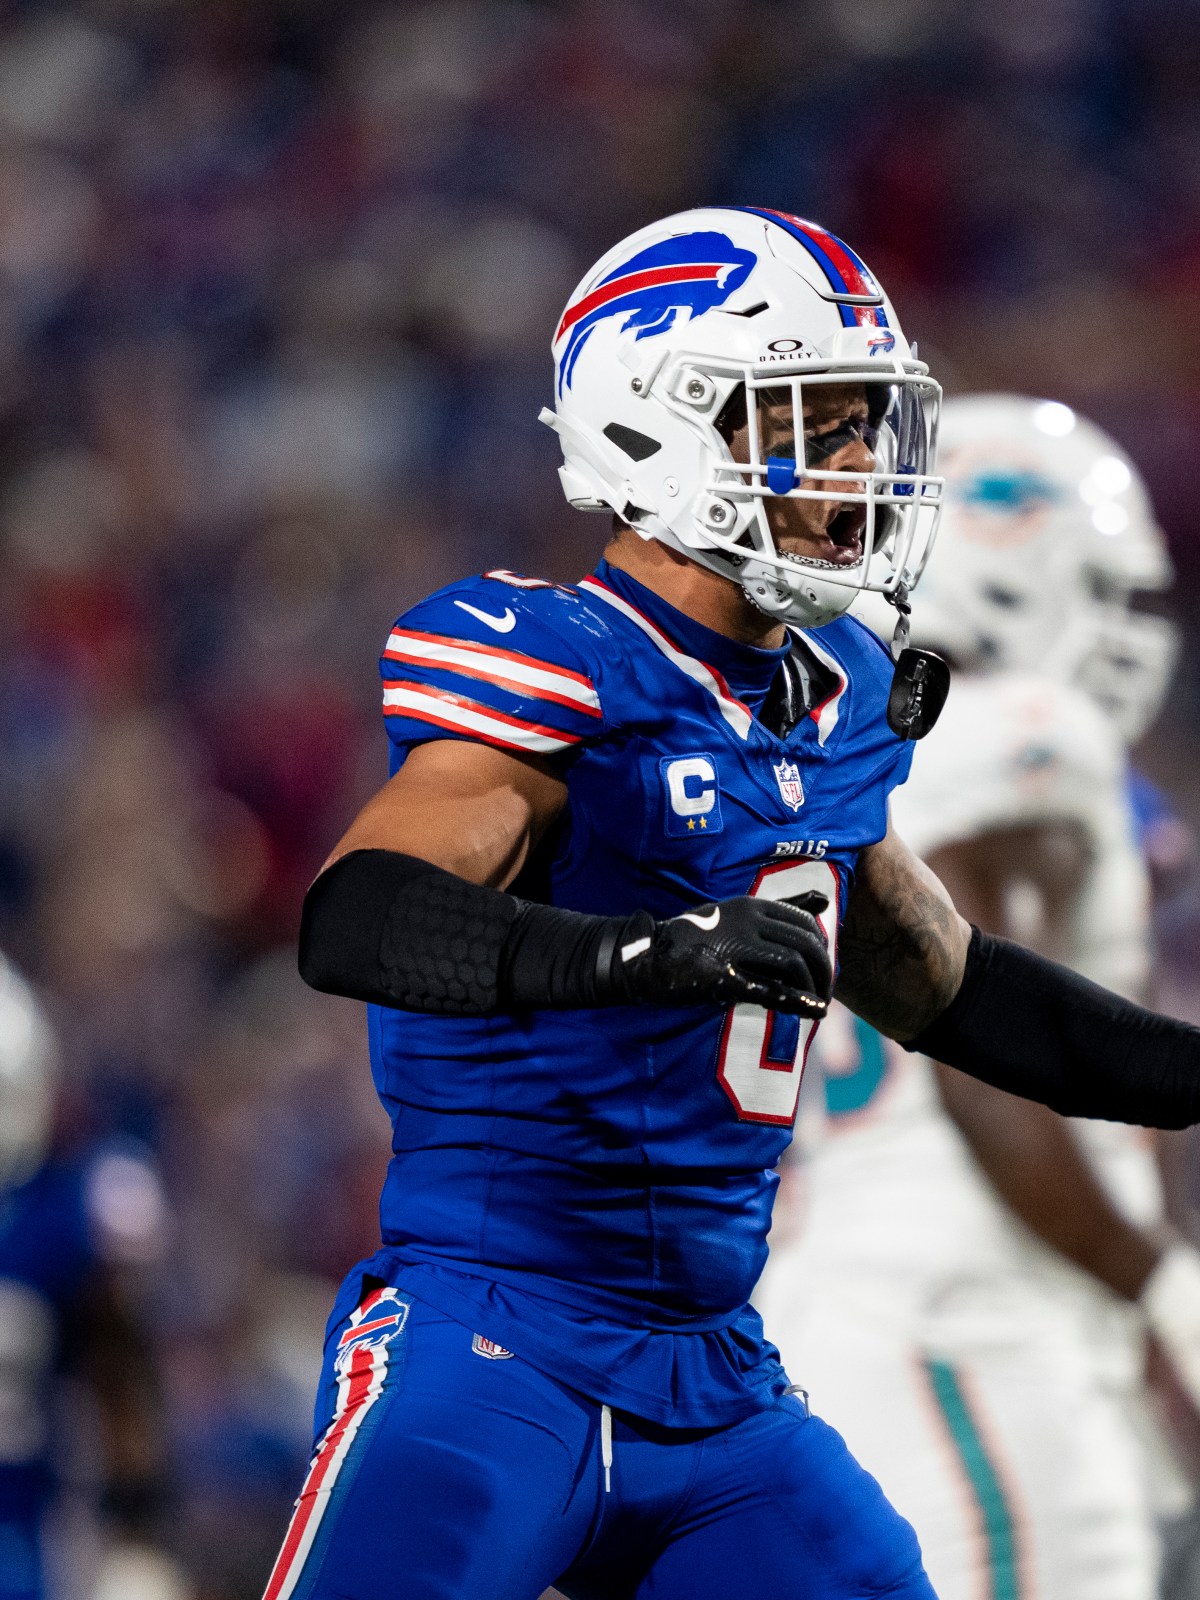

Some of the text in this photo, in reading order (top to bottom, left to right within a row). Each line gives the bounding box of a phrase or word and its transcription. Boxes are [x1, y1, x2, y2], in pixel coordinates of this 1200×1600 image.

[759, 352, 812, 362] OAKLEY
[667, 758, 716, 817] C
[782, 782, 801, 803] NFL
